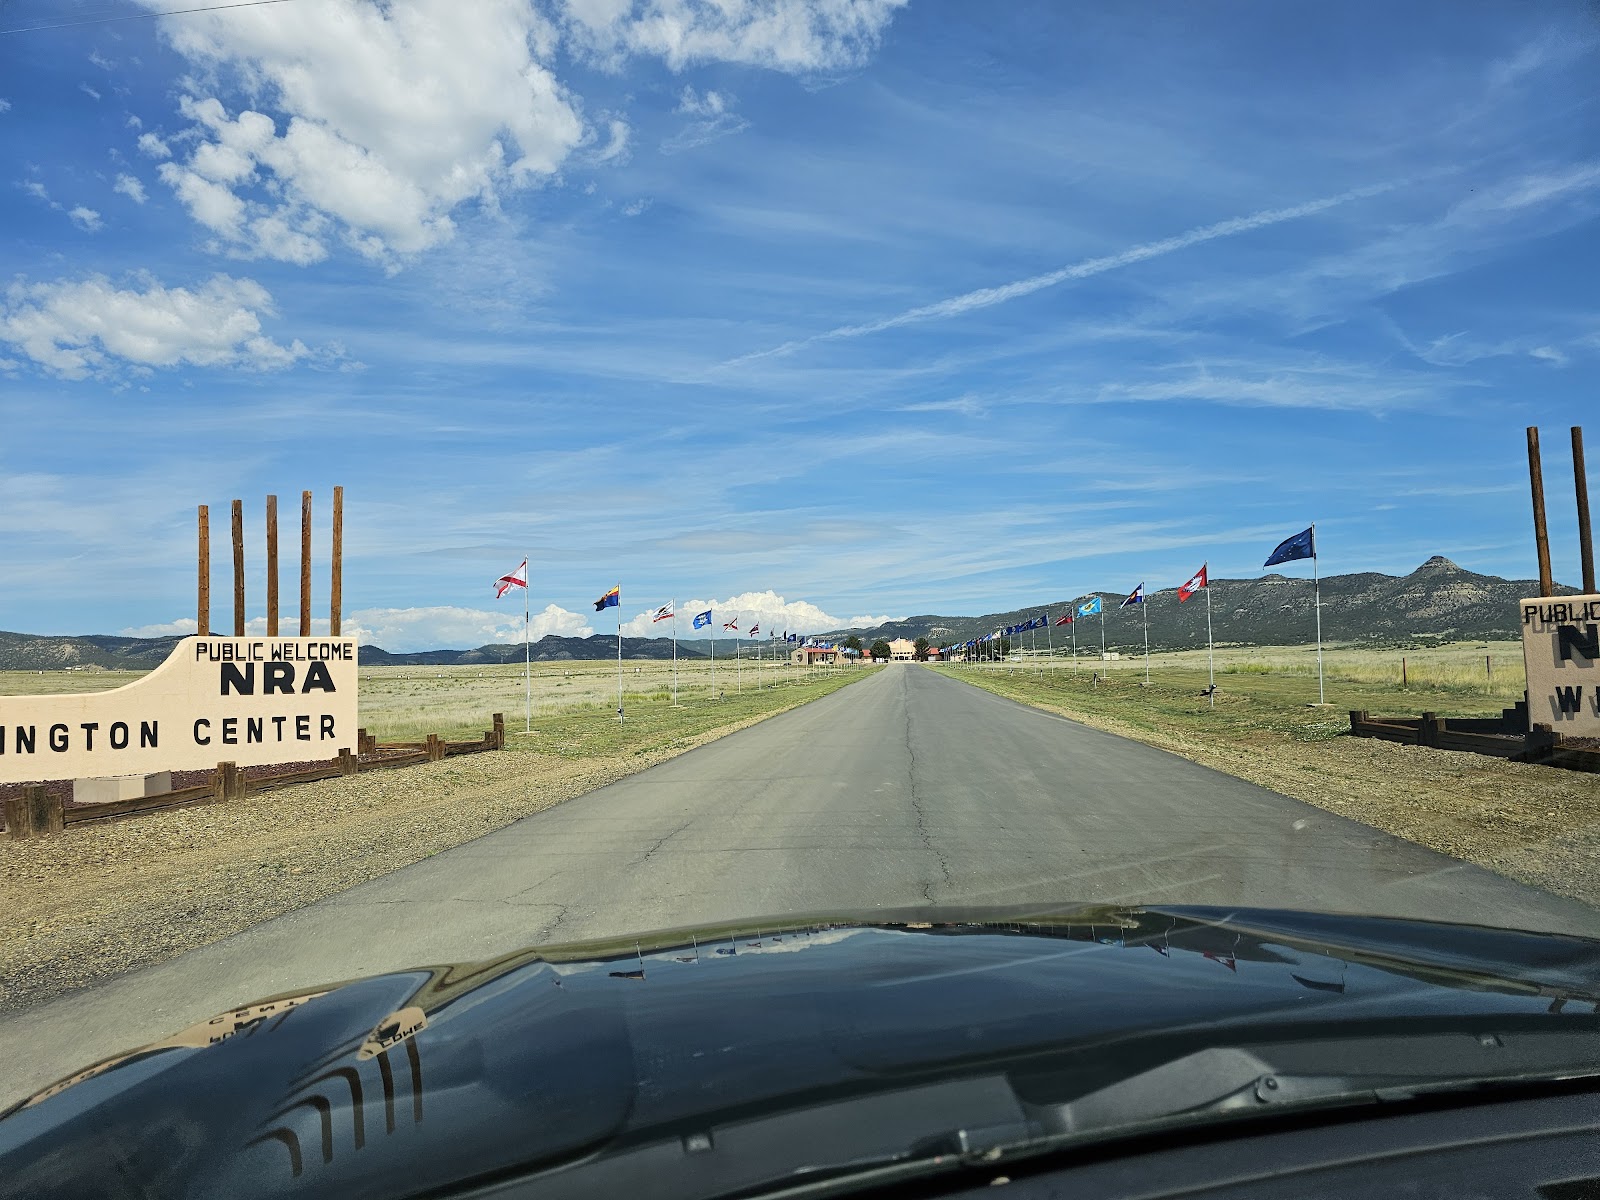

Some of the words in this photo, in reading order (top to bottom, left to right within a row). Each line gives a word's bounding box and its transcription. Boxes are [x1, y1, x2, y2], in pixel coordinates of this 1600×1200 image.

[196, 643, 263, 661] PUBLIC
[271, 643, 353, 661] WELCOME
[220, 661, 336, 695] NRA
[0, 721, 159, 755] INGTON
[193, 715, 336, 745] CENTER
